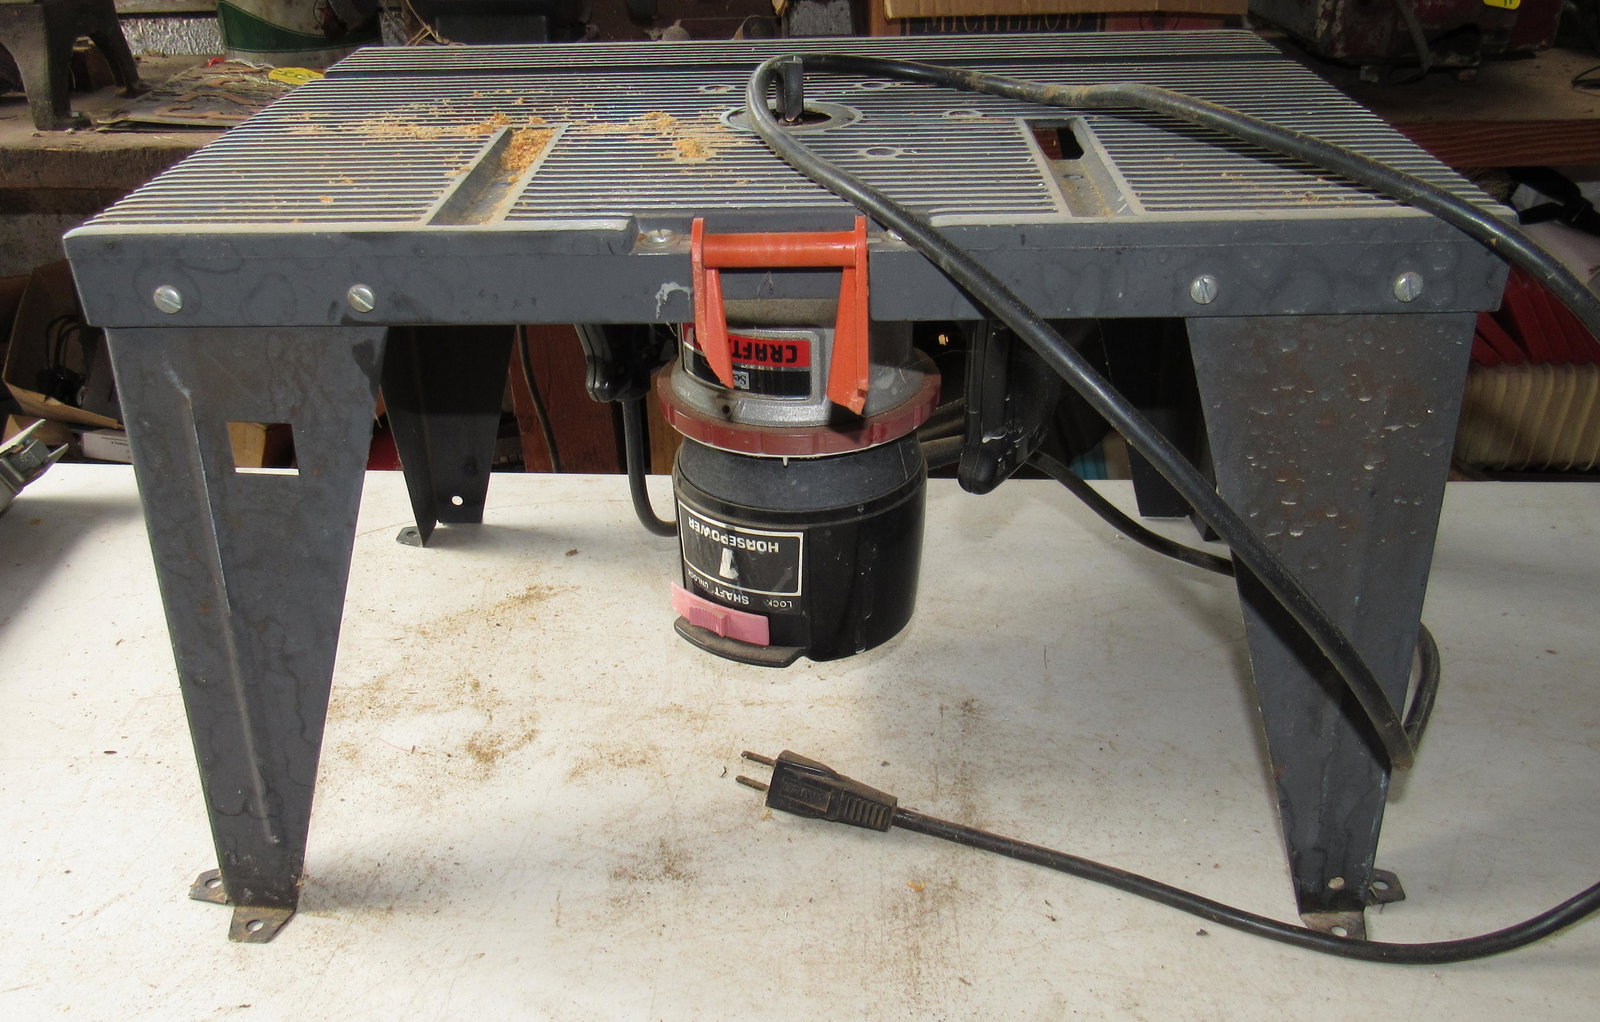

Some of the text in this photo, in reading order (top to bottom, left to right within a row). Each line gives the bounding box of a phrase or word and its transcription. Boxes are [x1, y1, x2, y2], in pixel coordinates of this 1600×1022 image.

[728, 339, 798, 363] CRAFT
[688, 516, 779, 553] HORSEPOWER
[719, 547, 739, 580] 1
[687, 568, 792, 608] LOCK SHAFT UNLOCK
